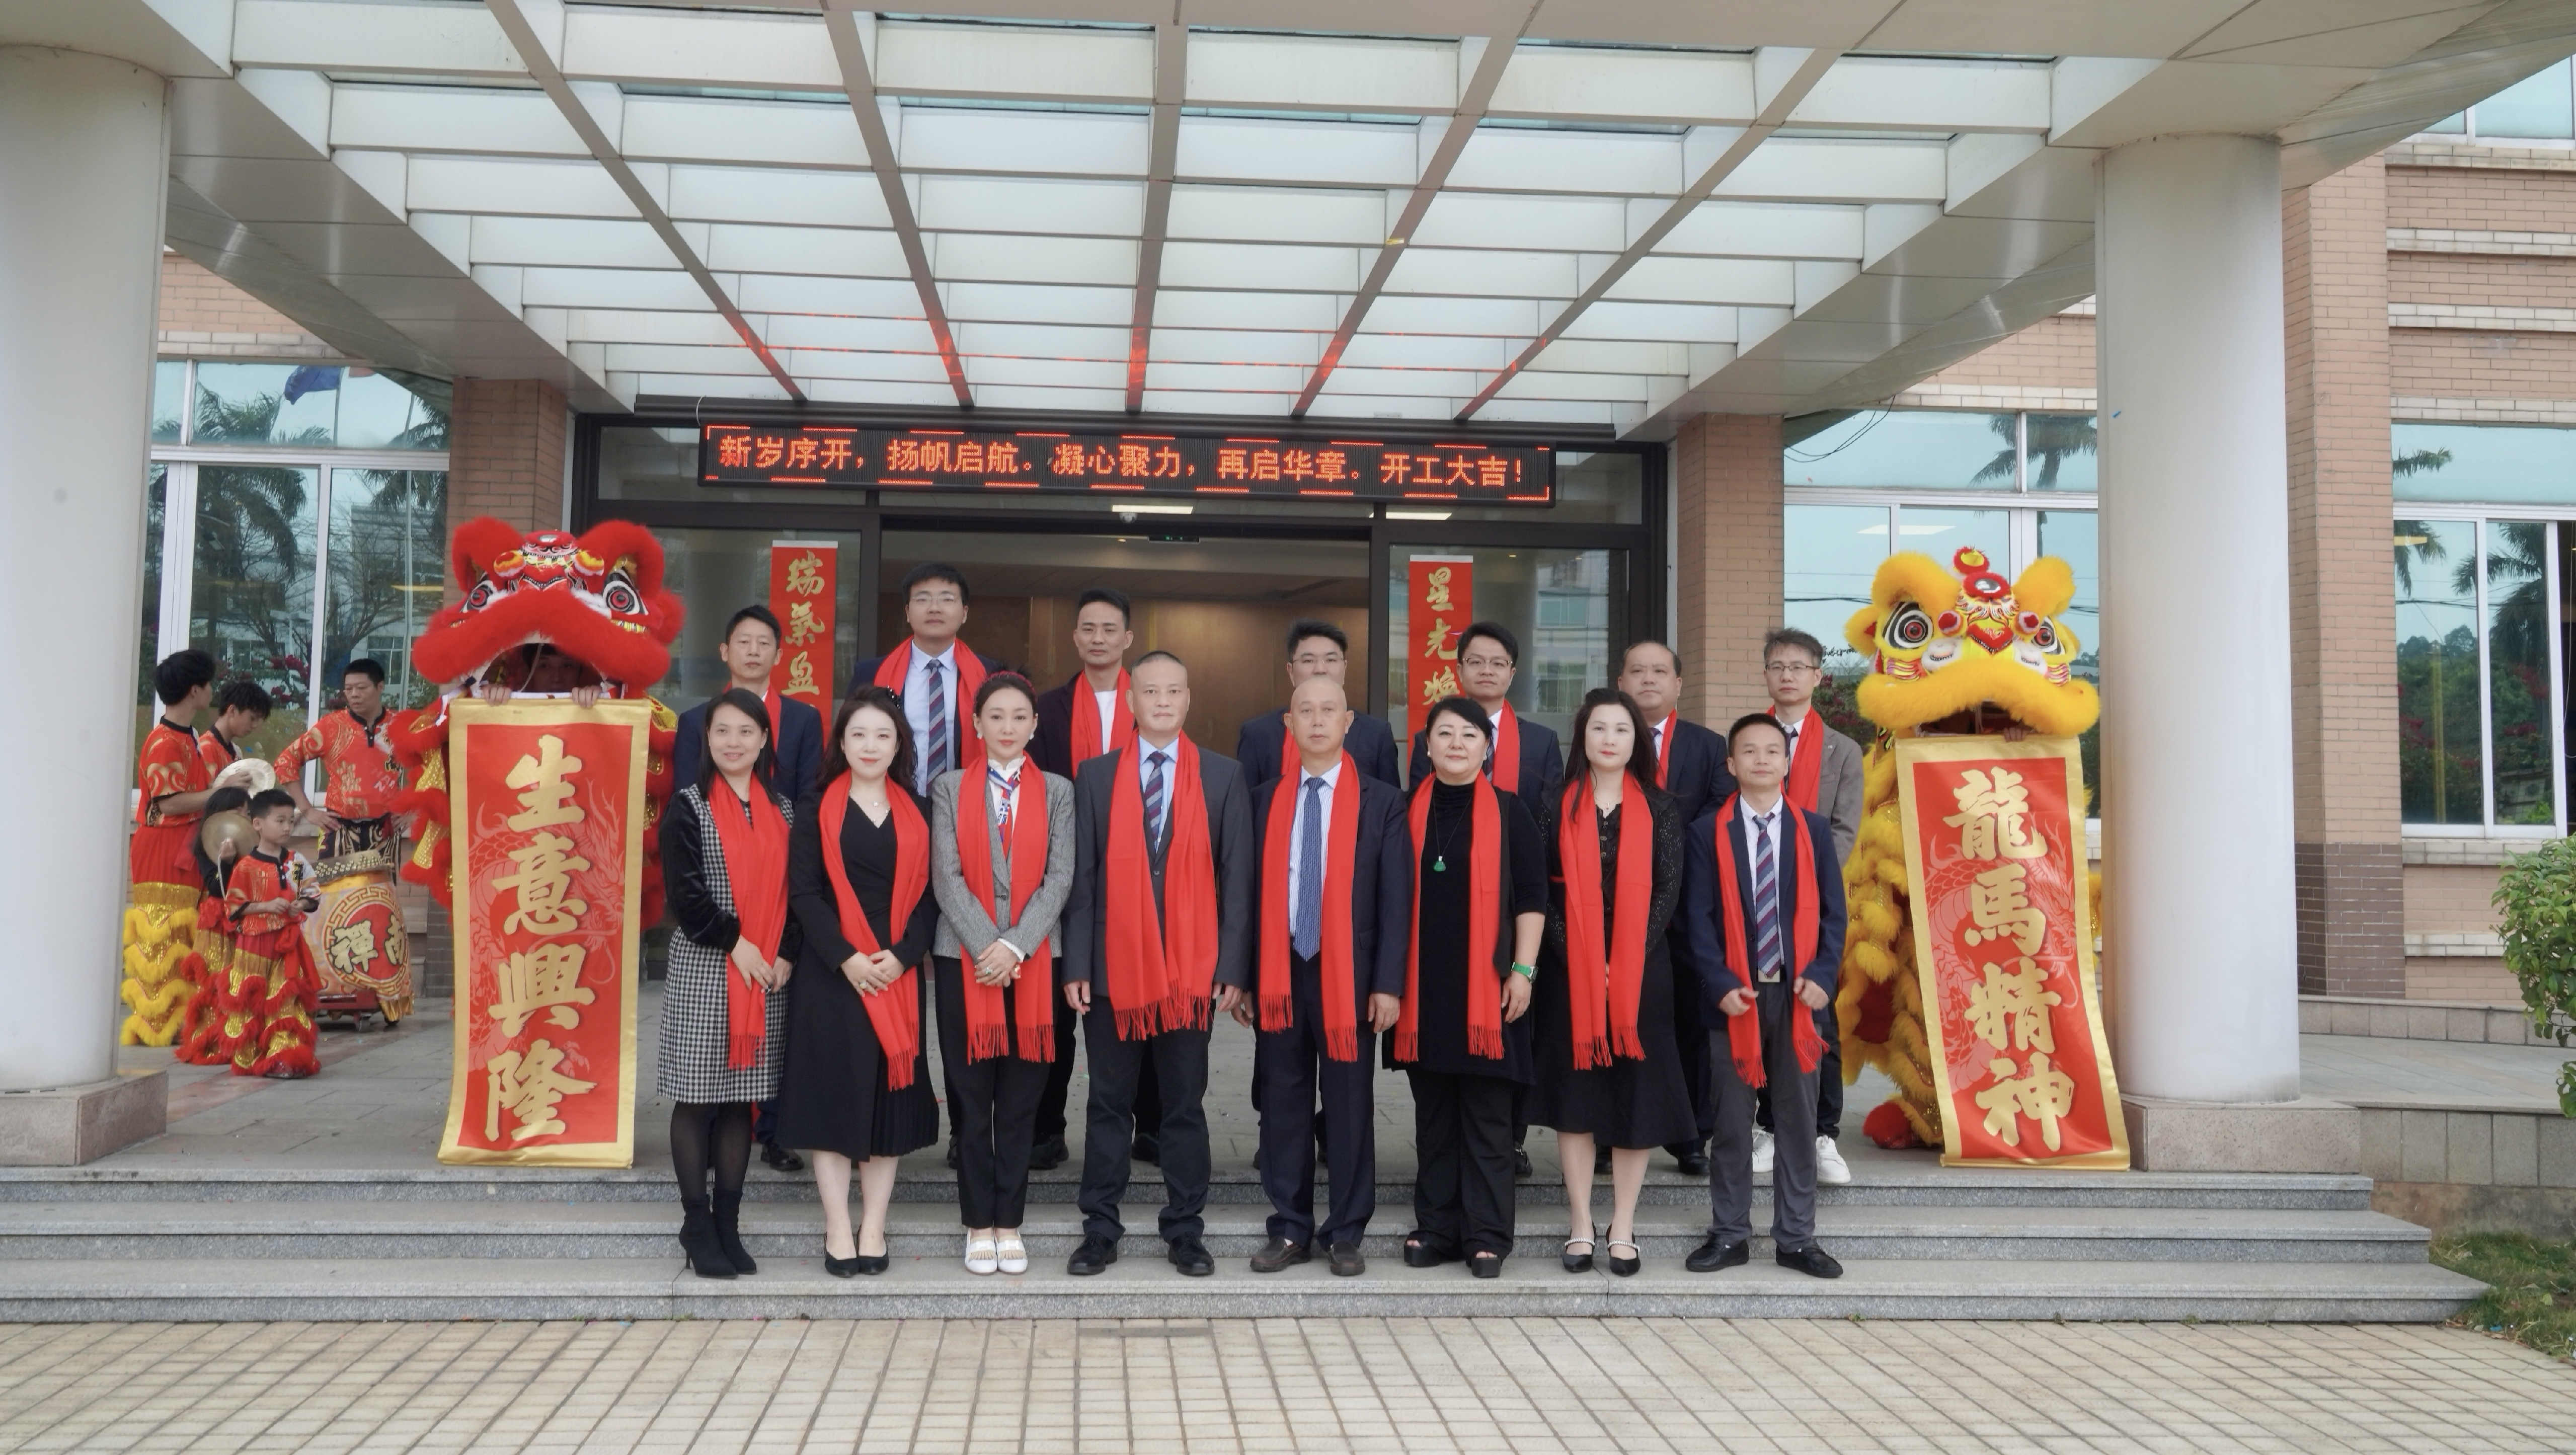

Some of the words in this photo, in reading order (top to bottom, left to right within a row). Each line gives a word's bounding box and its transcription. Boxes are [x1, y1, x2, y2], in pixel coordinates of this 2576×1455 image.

[781, 550, 825, 707] 瑞氣盈
[484, 734, 597, 1142] 生意興隆
[1942, 765, 2075, 1152] 龍馬精神
